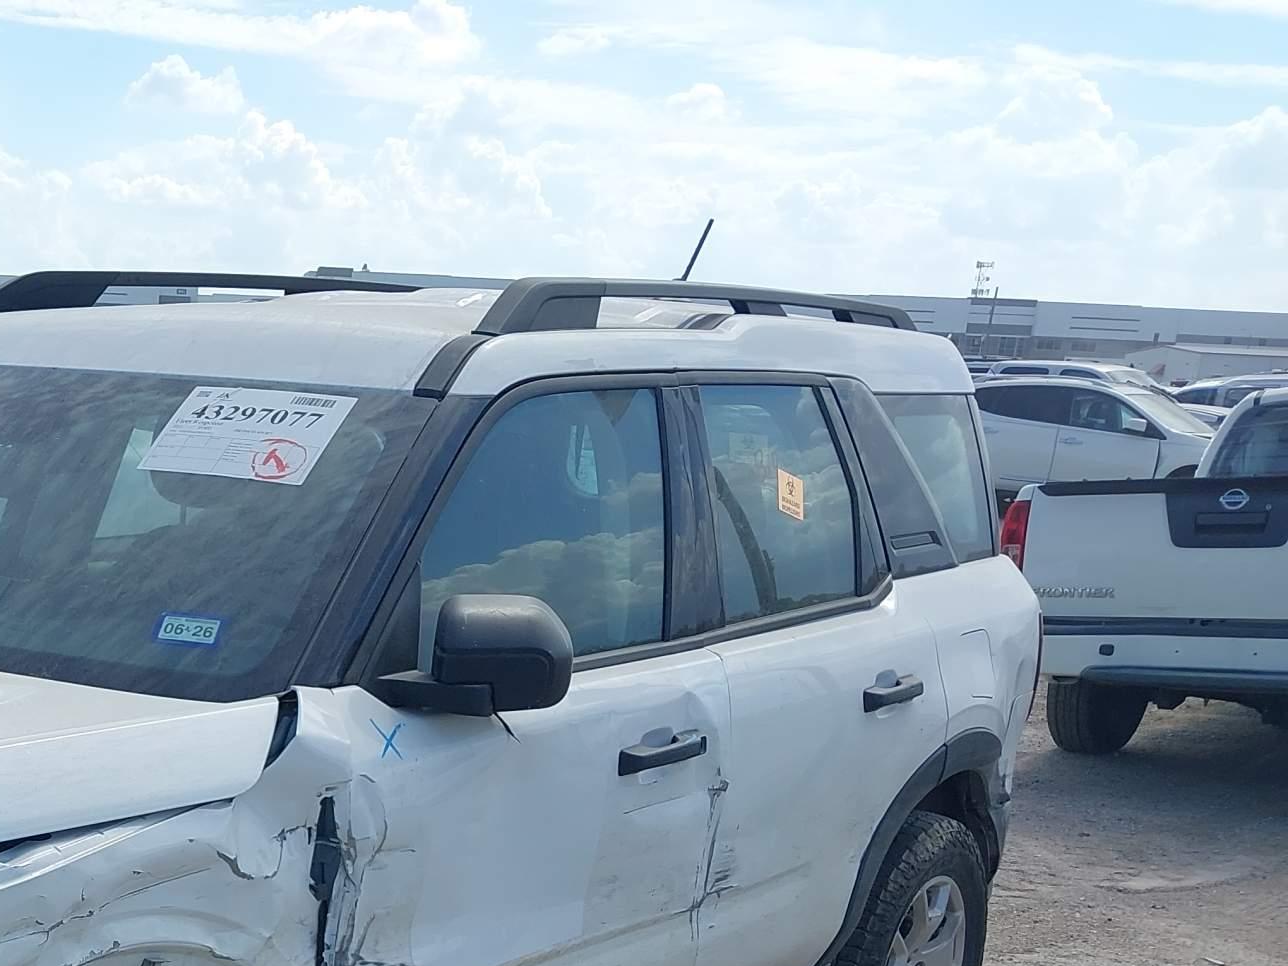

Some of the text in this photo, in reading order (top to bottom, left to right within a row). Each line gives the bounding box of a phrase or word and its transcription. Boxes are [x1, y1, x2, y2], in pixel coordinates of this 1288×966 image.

[191, 404, 327, 430] 43297077
[163, 622, 214, 639] 06 26
